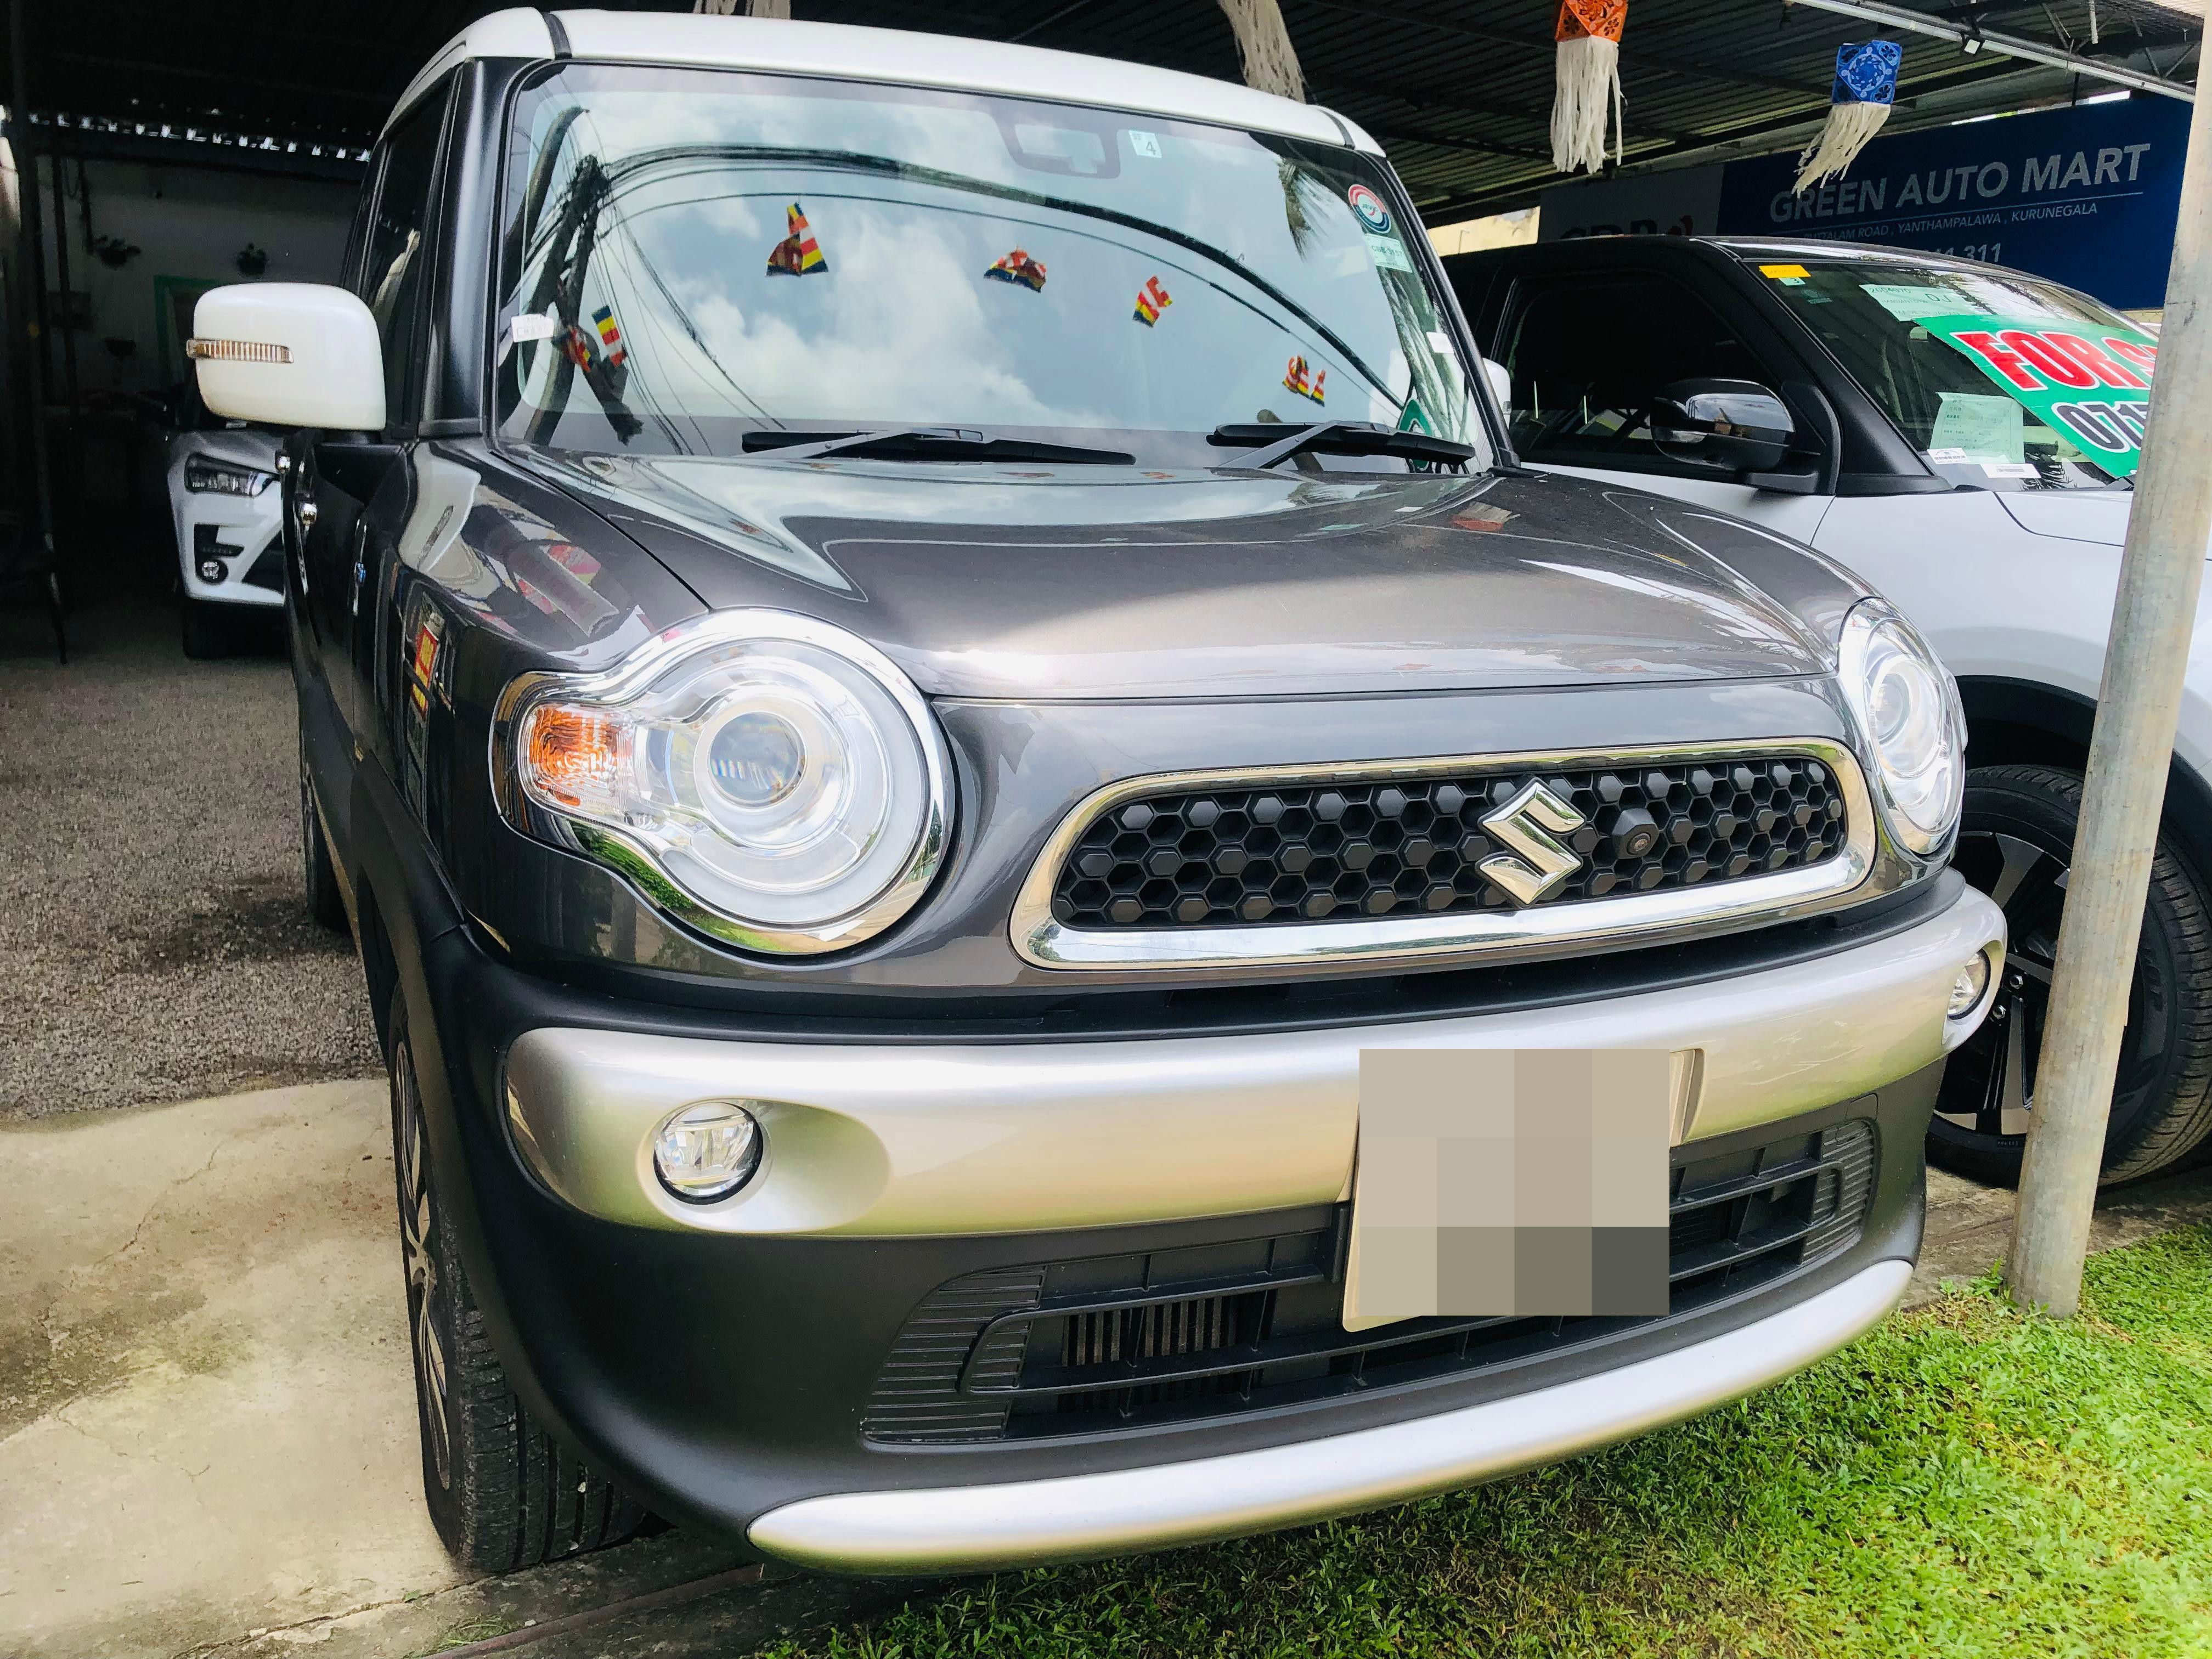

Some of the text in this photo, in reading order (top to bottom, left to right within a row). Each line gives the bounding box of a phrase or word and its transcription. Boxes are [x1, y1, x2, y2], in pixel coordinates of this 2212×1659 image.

[1146, 141, 1156, 155] 4
[1770, 143, 2151, 222] GREEN AUTO MART
[1898, 212, 2001, 233] YANTHAMPALAWA
[2011, 203, 2097, 222] KURUNEGALA
[1949, 330, 2152, 391] FOR
